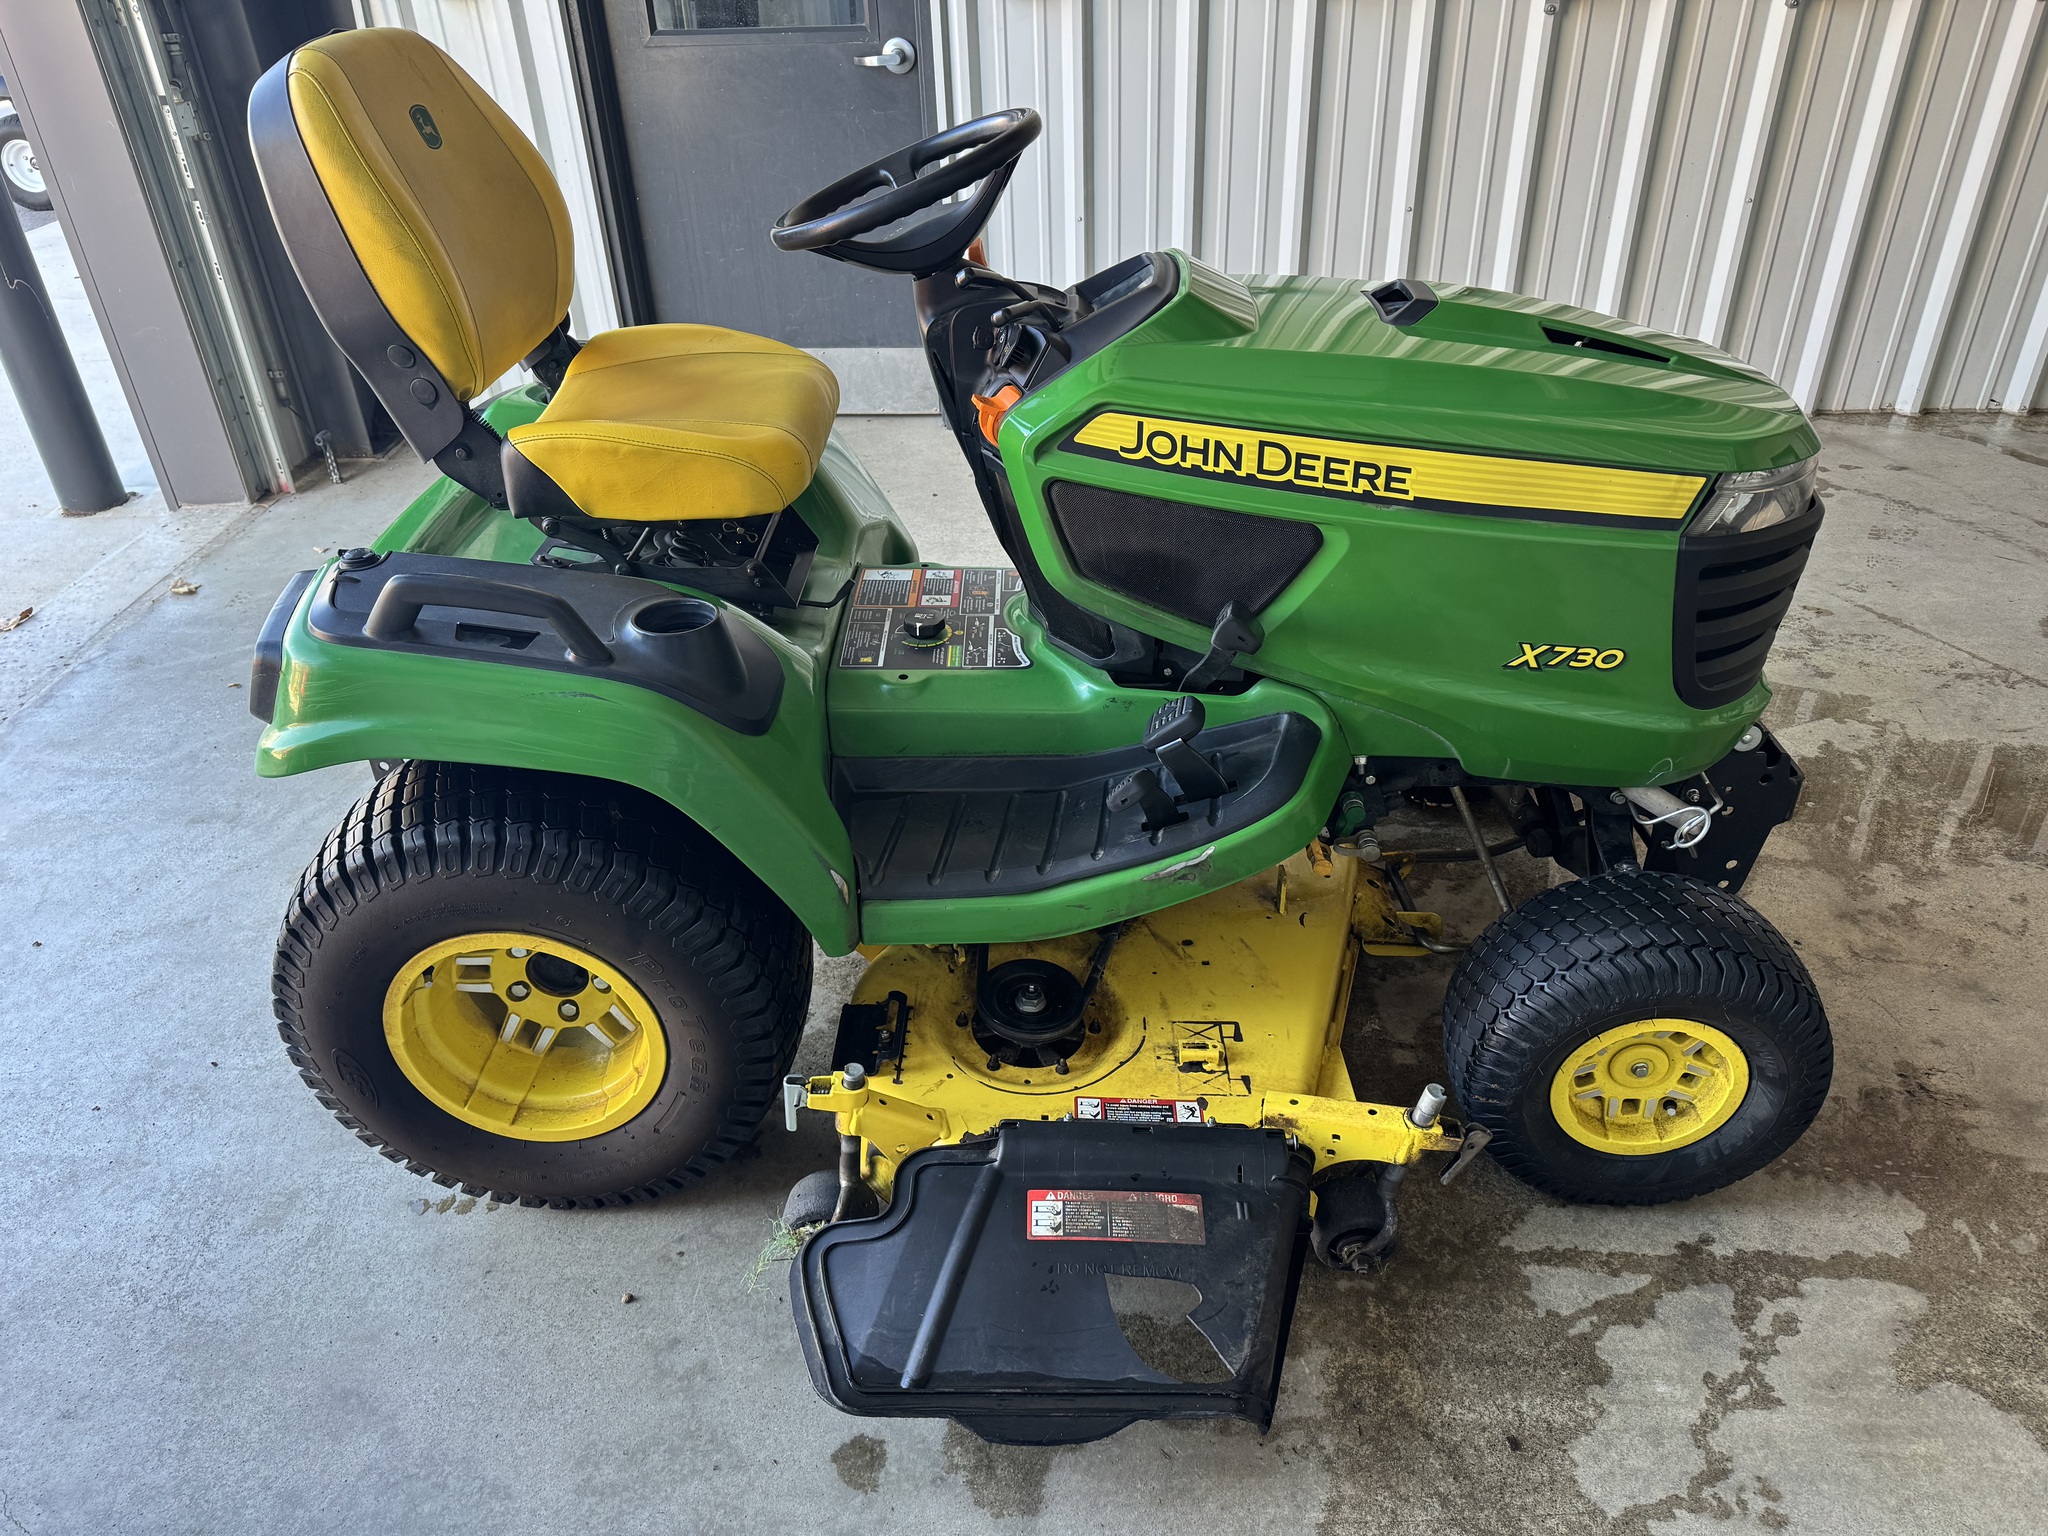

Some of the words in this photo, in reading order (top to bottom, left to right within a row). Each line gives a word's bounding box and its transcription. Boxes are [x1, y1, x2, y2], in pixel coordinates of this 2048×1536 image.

[1119, 420, 1244, 474] JOHN
[1257, 439, 1415, 499] DEERE
[1502, 642, 1627, 672] X730
